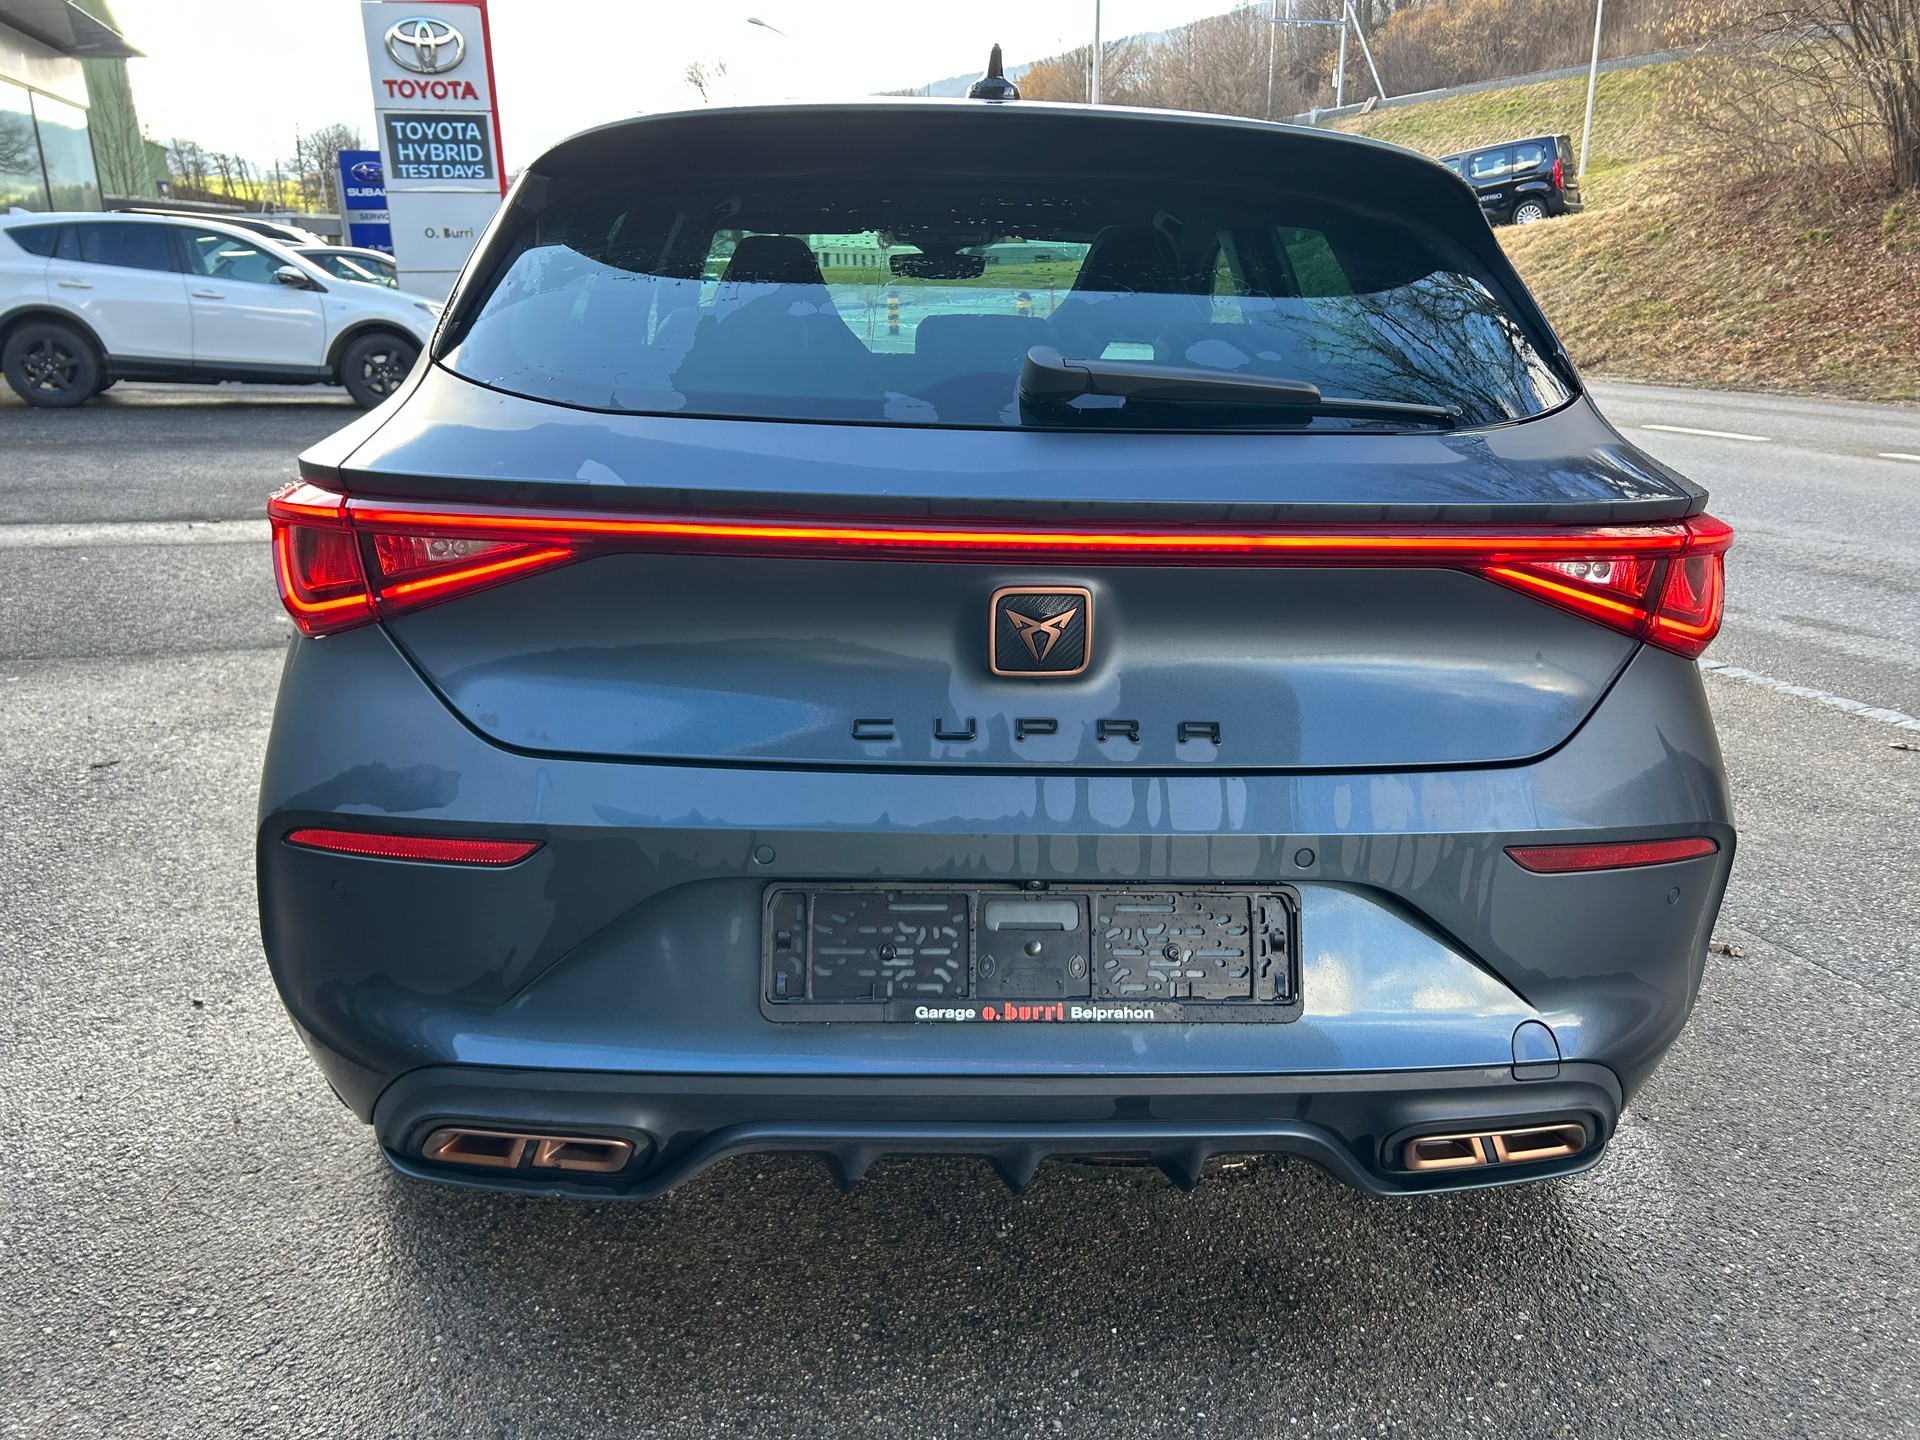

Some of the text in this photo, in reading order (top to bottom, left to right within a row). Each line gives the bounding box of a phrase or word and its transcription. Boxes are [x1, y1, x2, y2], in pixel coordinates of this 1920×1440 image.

[382, 79, 479, 100] TOYOTA
[391, 121, 482, 140] TOYOTA
[397, 143, 483, 161] HYBRID
[398, 164, 485, 178] TEST DAYS
[347, 187, 386, 197] SUBA
[425, 228, 473, 239] O. Burri
[851, 716, 1222, 745] CUPRA
[915, 1002, 1154, 1021] Garage o.burri Belprahon
